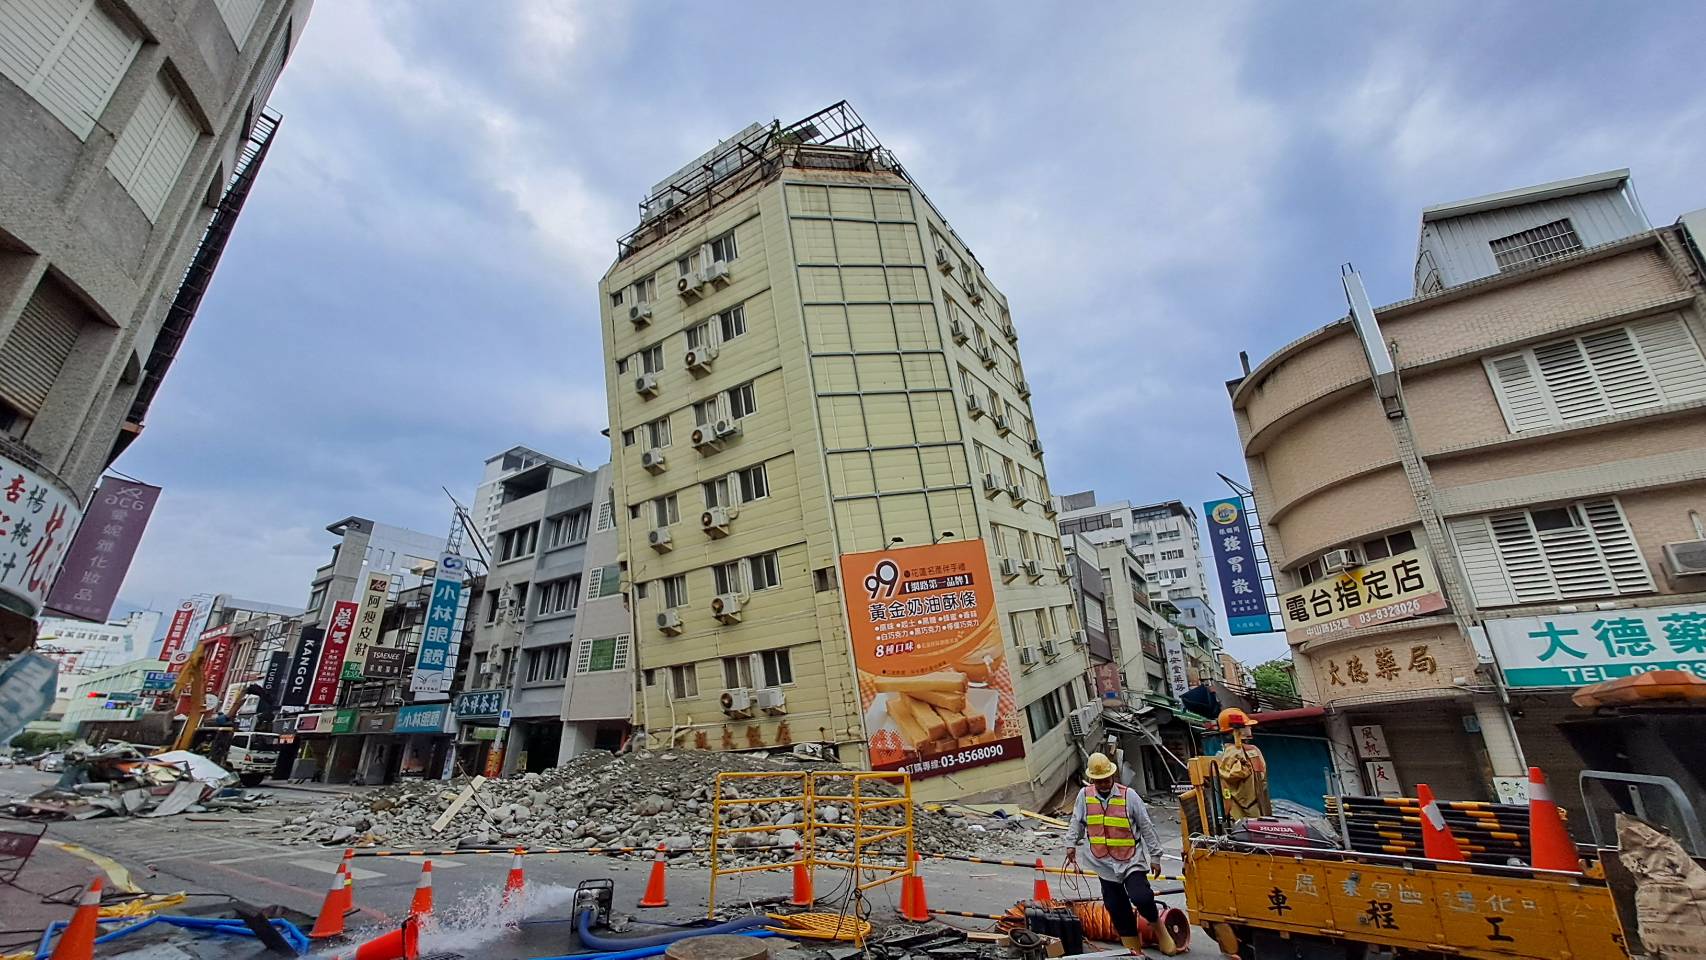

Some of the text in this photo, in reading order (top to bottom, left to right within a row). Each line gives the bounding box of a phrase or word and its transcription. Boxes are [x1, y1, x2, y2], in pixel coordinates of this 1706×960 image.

[865, 560, 899, 599] 99
[1222, 535, 1253, 595] 強胃散
[869, 591, 977, 622] 黃金奶油酥條
[1285, 558, 1424, 623] 電台指定店
[422, 584, 456, 666] 小林眼鏡
[1528, 611, 1706, 662] 大德藥
[291, 639, 316, 694] KANGOL
[1328, 644, 1438, 687] 大德藥局
[941, 744, 1004, 768] 03-8568090
[1259, 825, 1295, 833] HONDA
